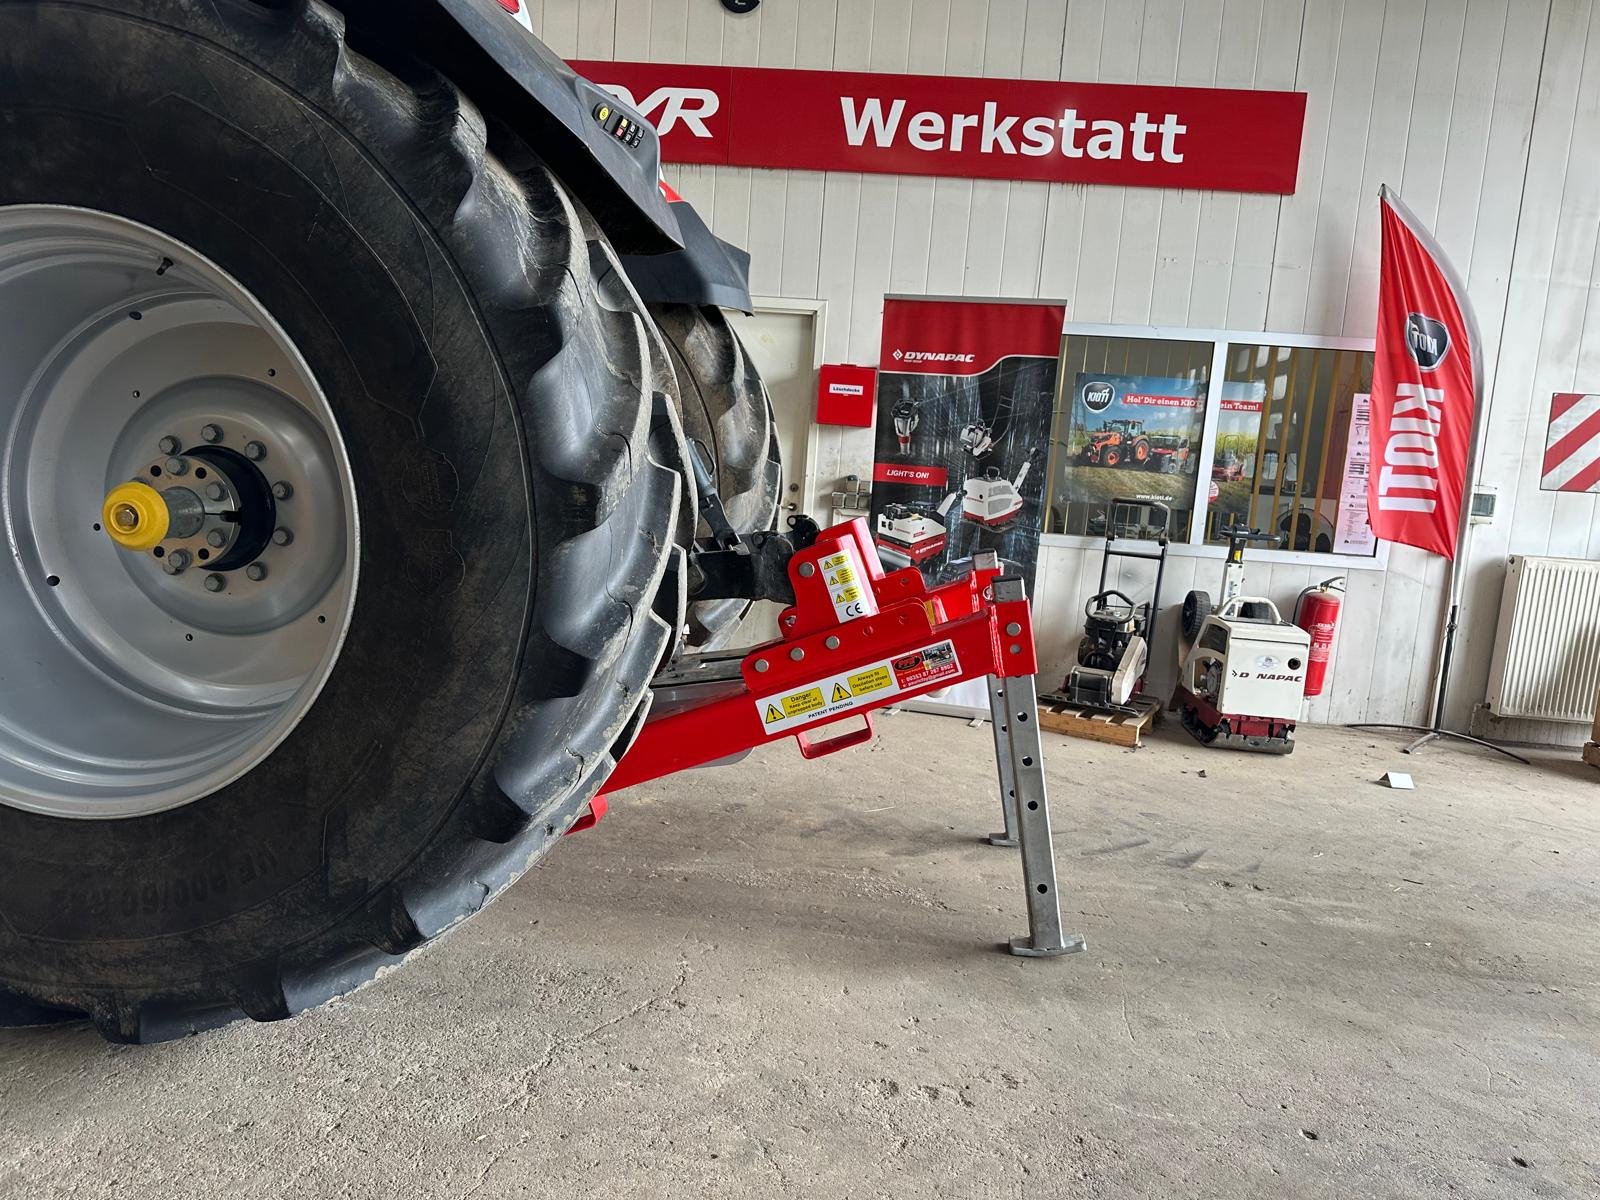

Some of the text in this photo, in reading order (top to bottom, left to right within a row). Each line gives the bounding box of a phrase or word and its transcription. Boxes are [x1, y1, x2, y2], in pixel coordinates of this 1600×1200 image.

[840, 96, 1187, 164] Werkstatt
[904, 351, 975, 363] DYNAPAC
[1087, 387, 1109, 403] KIOTI
[1144, 397, 1156, 405] Dir
[1157, 398, 1179, 406] einen
[1234, 402, 1259, 411] Team!
[886, 469, 930, 479] LIGHT'S ON!
[791, 692, 812, 702] Danger
[808, 702, 853, 718] PATENT PENDING
